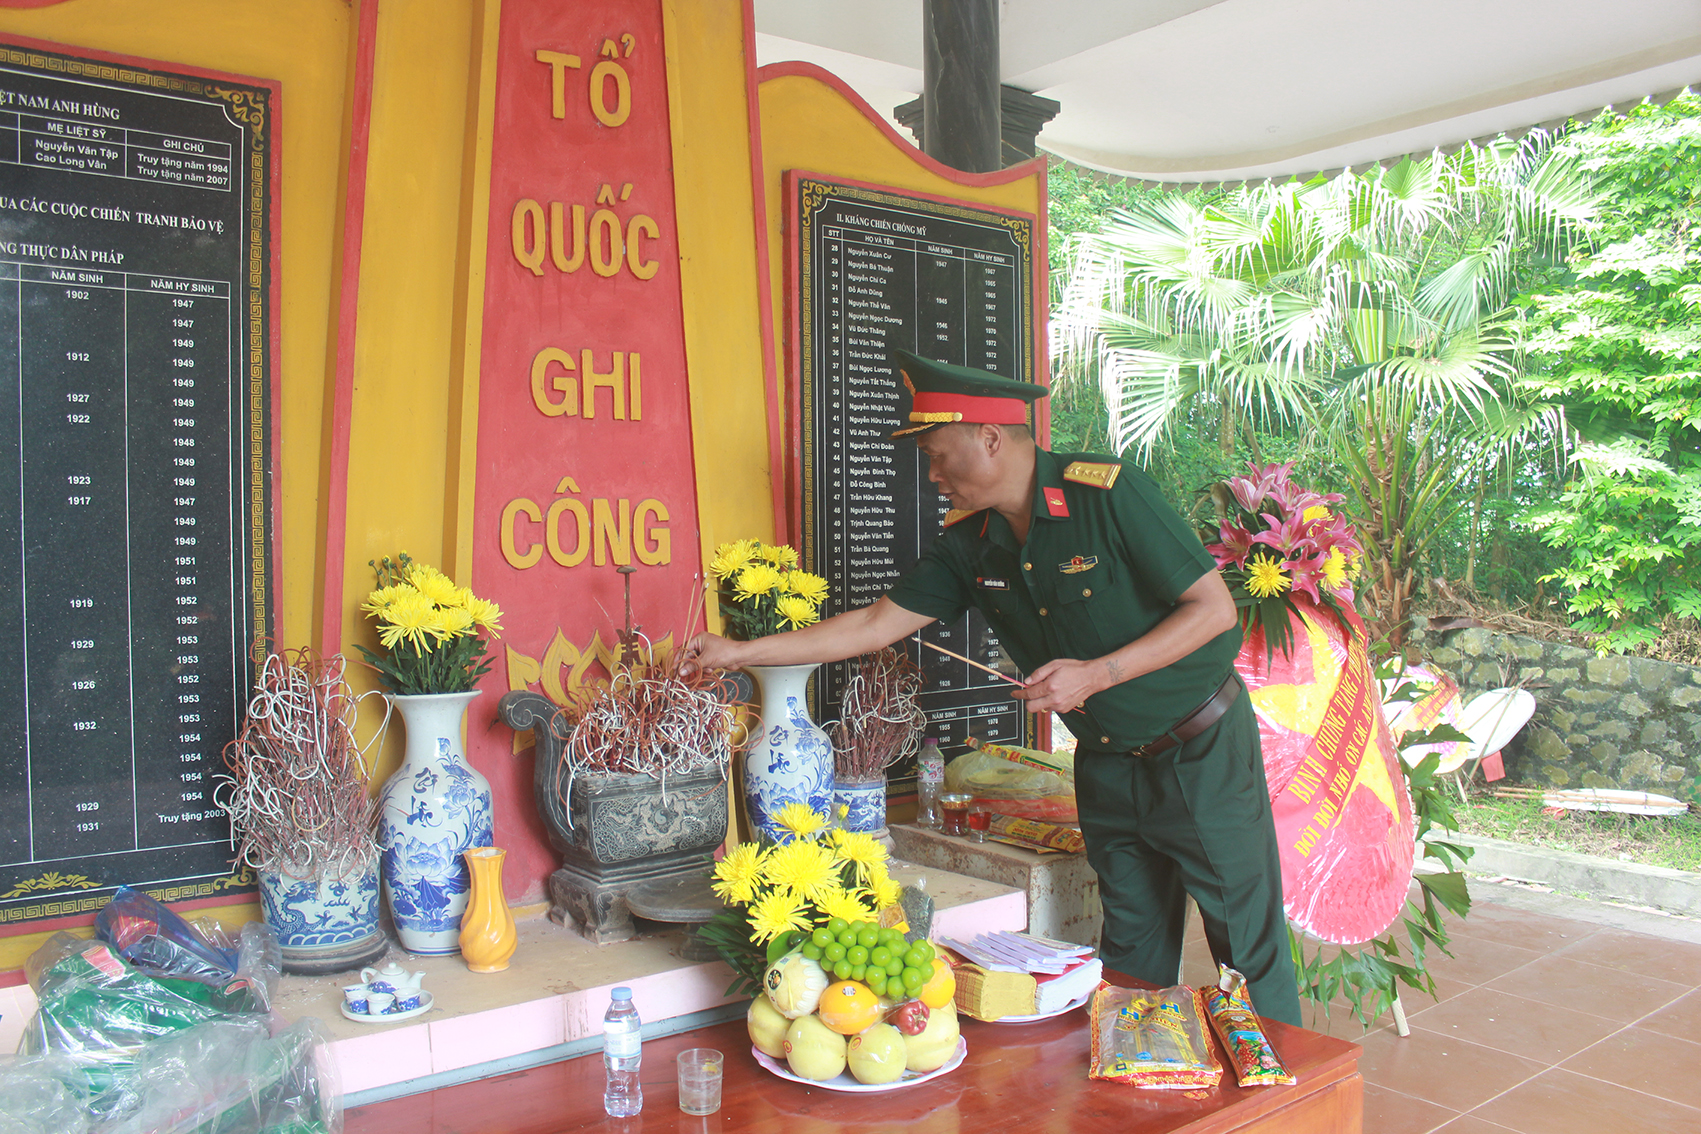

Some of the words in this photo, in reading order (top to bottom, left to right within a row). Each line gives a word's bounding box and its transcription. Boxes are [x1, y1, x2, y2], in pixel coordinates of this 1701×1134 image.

[535, 33, 635, 128] TỔ
[18, 93, 49, 110] NAM
[51, 99, 80, 114] ANH
[83, 102, 120, 120] HÙNG
[47, 122, 64, 134] MẸ
[66, 126, 90, 137] LIỆT
[92, 128, 106, 139] SỸ
[35, 139, 75, 155] Nguyễn
[78, 144, 97, 156] Văn
[100, 146, 118, 159] Tập
[163, 139, 181, 149] GHI
[183, 142, 204, 153] CHÚ
[35, 152, 57, 164] Cao
[59, 155, 85, 168] Long
[87, 157, 107, 170] Vân
[137, 153, 159, 166] Truy
[161, 157, 182, 169] tặng
[184, 161, 204, 171] năm
[207, 163, 228, 173] 1994
[137, 166, 159, 178] Truy
[161, 169, 182, 181] tặng
[184, 173, 204, 183] năm
[206, 175, 228, 185] 2007
[20, 197, 49, 213] CÁC
[50, 202, 88, 219] CUỘC
[90, 206, 131, 222] CHIẾN
[181, 215, 206, 231] BẢO
[208, 219, 224, 235] VỆ
[845, 214, 870, 227] KHÁNG
[870, 219, 891, 230] CHIẾN
[892, 222, 915, 234] CHỐNG
[511, 183, 661, 281] QUỐC
[828, 229, 840, 237] STT
[864, 235, 874, 243] HỌ
[874, 236, 882, 244] VÀ
[883, 237, 894, 245] TÊN
[20, 243, 58, 260] THỰC
[61, 245, 88, 261] DÂN
[91, 249, 124, 265] PHÁP
[51, 269, 76, 281] NĂM
[78, 273, 104, 284] SINH
[150, 279, 173, 290] NĂM
[176, 282, 190, 291] HY
[191, 283, 215, 294] SINH
[65, 289, 90, 299] 1902
[172, 298, 195, 309] 1947
[172, 318, 195, 329] 1947
[172, 338, 195, 348] 1949
[66, 351, 90, 361] 1912
[172, 357, 195, 368] 1949
[172, 377, 195, 388] 1949
[529, 346, 643, 422] GHI
[66, 393, 90, 402] 1927
[172, 397, 195, 408] 1949
[66, 413, 91, 424] 1922
[172, 417, 195, 428] 1949
[172, 437, 195, 447] 1948
[173, 457, 196, 467] 1949
[67, 475, 92, 484] 1923
[173, 477, 196, 487] 1949
[67, 496, 92, 505] 1917
[173, 497, 196, 506] 1947
[173, 517, 196, 526] 1949
[499, 476, 672, 571] CÔNG
[865, 520, 882, 528] Quang
[174, 536, 197, 546] 1949
[871, 545, 889, 553] Quang
[174, 556, 196, 566] 1951
[174, 576, 196, 586] 1951
[69, 597, 94, 608] 1919
[175, 596, 198, 606] 1952
[175, 615, 198, 625] 1952
[70, 639, 95, 648] 1929
[176, 635, 199, 645] 1953
[176, 654, 199, 665] 1953
[177, 673, 200, 684] 1952
[71, 679, 96, 690] 1926
[177, 694, 200, 704] 1953
[178, 713, 201, 724] 1953
[73, 720, 98, 730] 1932
[178, 733, 201, 743] 1954
[1287, 755, 1328, 805] BINH
[1334, 672, 1359, 717] TĂNG
[179, 752, 202, 763] 1954
[180, 772, 203, 783] 1954
[1293, 825, 1322, 858] ĐỜI
[1313, 797, 1339, 830] ĐỜI
[1352, 719, 1369, 747] CÁC
[180, 791, 203, 802] 1954
[75, 801, 100, 811] 1929
[158, 813, 180, 824] Truy
[181, 812, 202, 822] tặng
[204, 808, 226, 818] 2003
[76, 821, 101, 831] 1931
